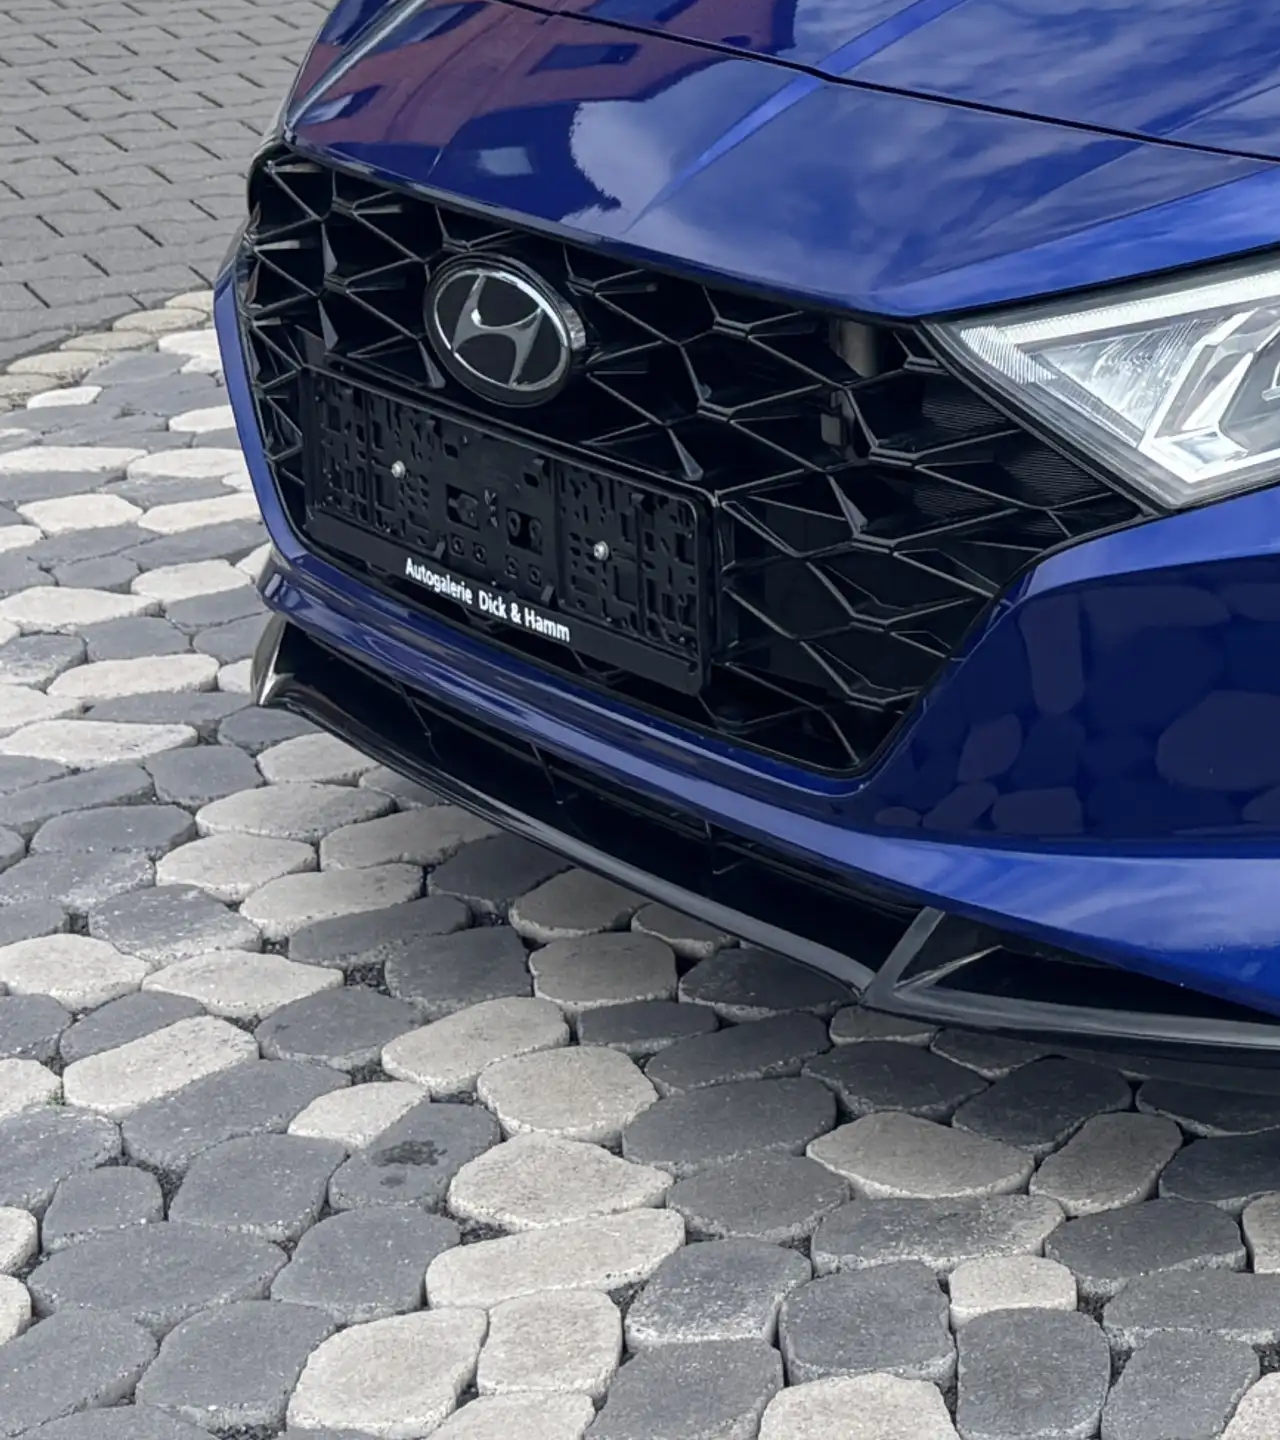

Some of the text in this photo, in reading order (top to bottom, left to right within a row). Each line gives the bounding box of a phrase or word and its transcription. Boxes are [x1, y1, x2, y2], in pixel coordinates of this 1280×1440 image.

[405, 557, 571, 643] Autogalerie Dick & Hamm
